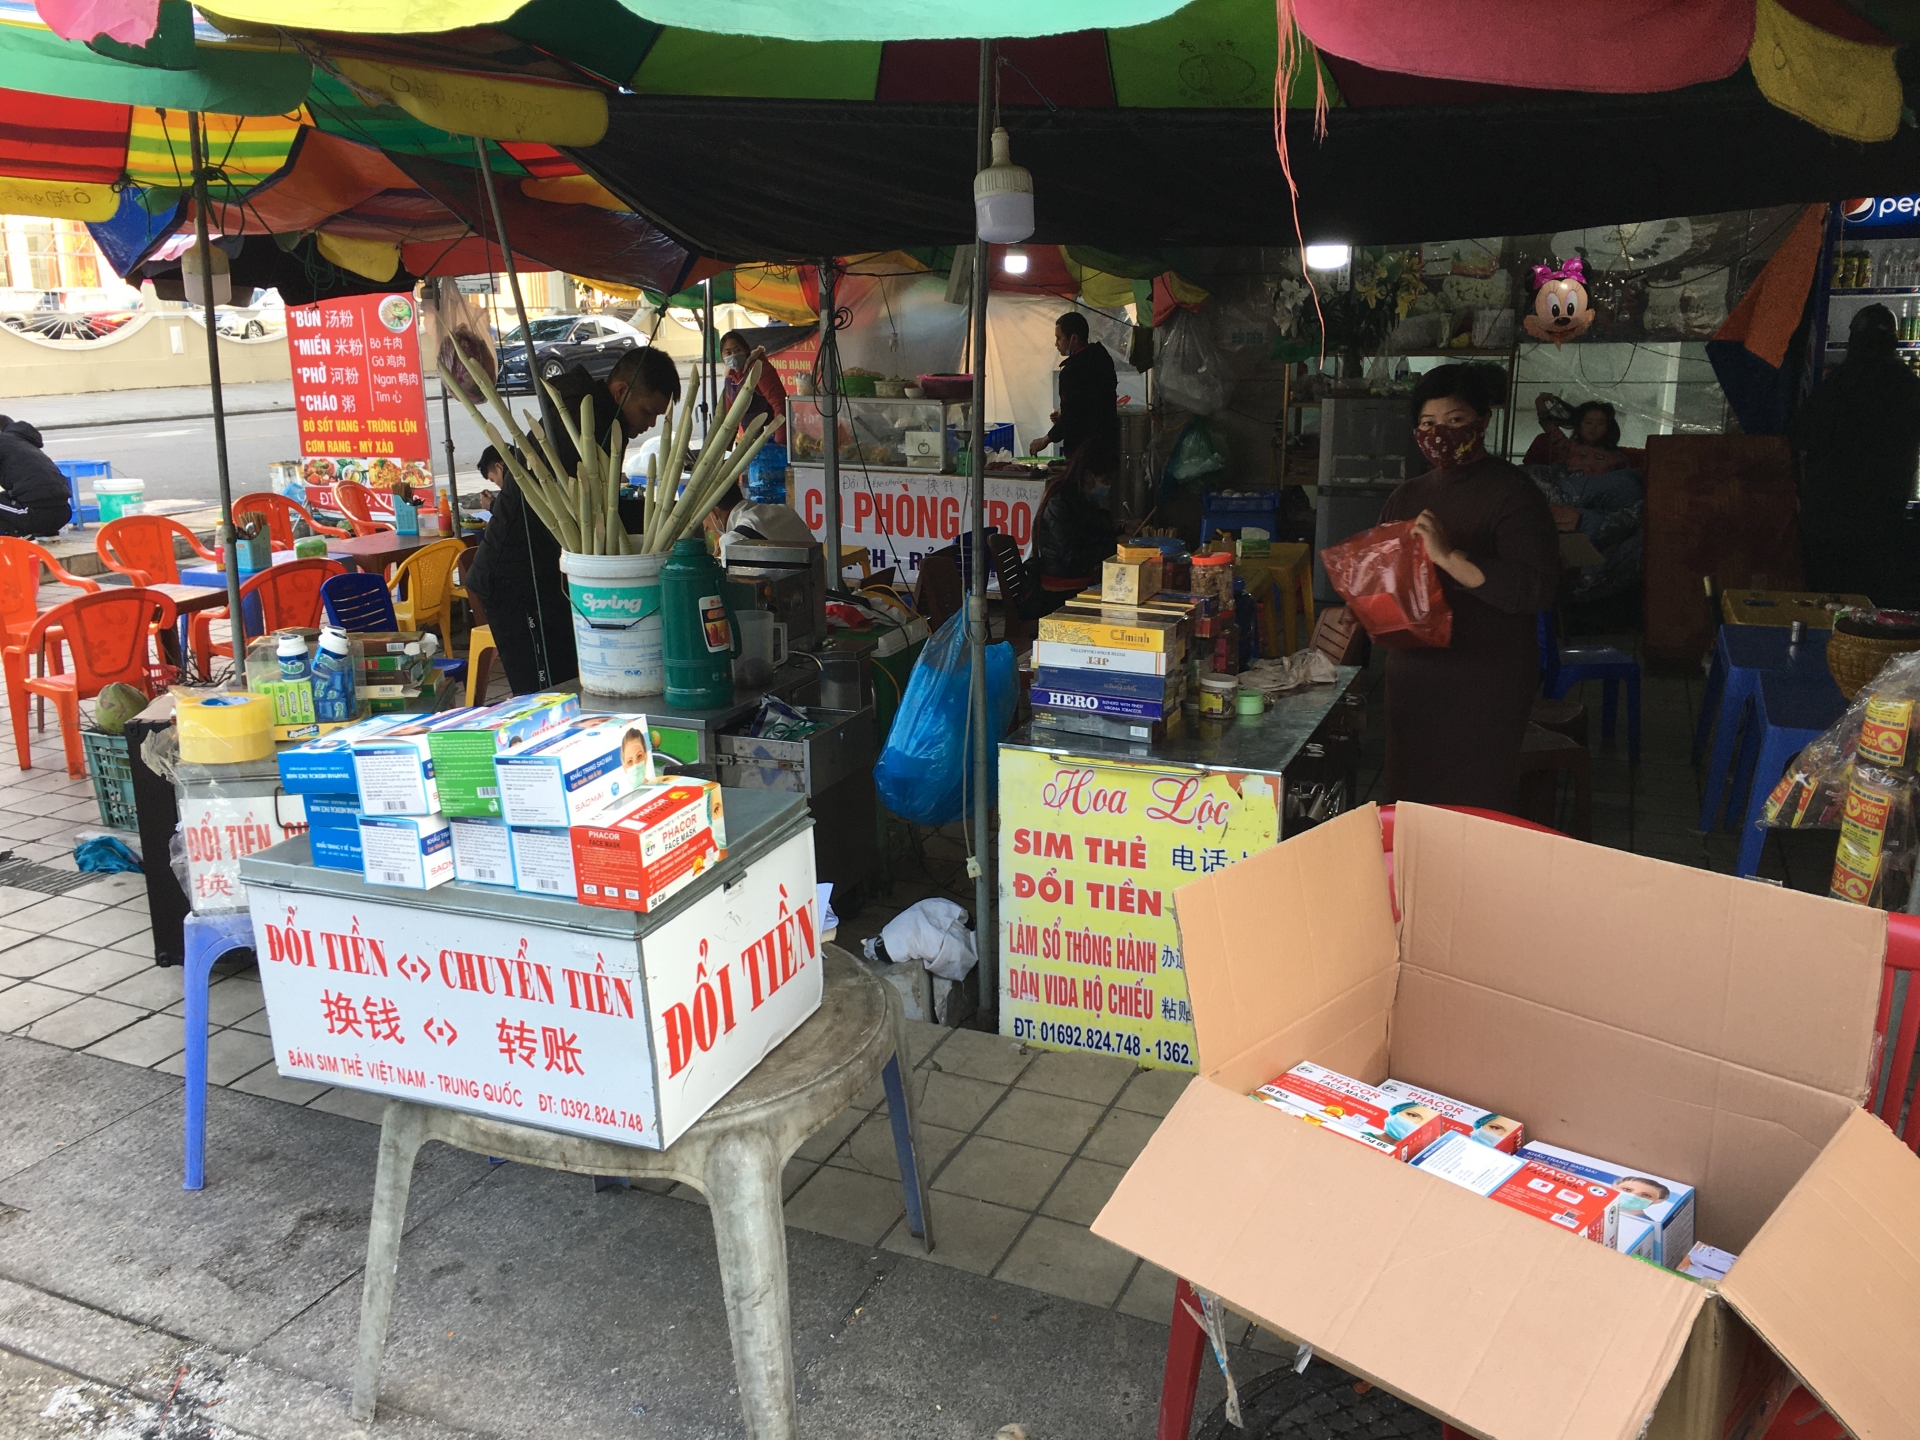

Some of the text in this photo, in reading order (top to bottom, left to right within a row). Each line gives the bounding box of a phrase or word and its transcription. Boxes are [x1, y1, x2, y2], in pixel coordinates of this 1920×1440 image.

[296, 307, 322, 327] BÚN
[325, 309, 354, 328] 汤粉
[334, 338, 363, 356] 米粉
[369, 337, 381, 349] Bò
[383, 338, 403, 350] 牛肉
[372, 355, 384, 367] Gà
[386, 355, 406, 368] 鸡肉
[302, 362, 327, 384] PHỞ
[330, 367, 359, 385] 河粉
[373, 374, 397, 387] Ngan
[398, 373, 419, 386] 鸭肉
[305, 391, 338, 412] CHÁO
[341, 394, 356, 413] 粥
[375, 391, 390, 403] Tim
[392, 392, 402, 404] 心
[303, 416, 417, 436] BÒ SỐT VANG TRỨNG LỘN
[305, 439, 325, 453] CƠM
[327, 440, 351, 453] RANG
[375, 438, 394, 453] XÀO
[854, 483, 960, 541] PHÒNG
[582, 593, 642, 613] Spring
[1086, 656, 1109, 666] JET
[1048, 692, 1099, 710] HERO
[1043, 769, 1230, 831] Hoa Lộc
[186, 811, 272, 862] ĐỔI TIỀN
[588, 830, 620, 841] PHACOR
[662, 814, 697, 843] PHACOR
[589, 839, 604, 847] FACE
[665, 828, 697, 852] FACE MASK
[1013, 828, 1147, 869] SIM THẺ
[195, 873, 234, 898] 换
[1013, 867, 1162, 917] ĐỔI TIỀN
[265, 907, 389, 978] ĐỔI TIỀN
[1009, 916, 1157, 974] LÀM SỔ THÔNG HÀNH
[439, 938, 635, 1020] CHUYỂN TIỀN
[661, 883, 816, 1079] ĐỔI TIỀN
[1009, 964, 1153, 1020] DÁN VIDA HỘ CHIẾU
[321, 990, 405, 1045] 换钱
[496, 1017, 585, 1076] 转账
[1014, 1017, 1036, 1040] ĐT:
[1040, 1021, 1141, 1057] 01692.824.748
[288, 1049, 314, 1071] BÁN
[317, 1055, 339, 1073] SIM
[341, 1053, 364, 1078] THẺ
[367, 1059, 395, 1085] VIỆT
[397, 1068, 427, 1089] NAM
[438, 1074, 480, 1098] TRUNG
[483, 1080, 523, 1108] QUỐC
[1322, 1074, 1381, 1100] PHACOR
[1275, 1089, 1290, 1099] Pcs
[1319, 1079, 1375, 1102] FACE MASK
[538, 1093, 643, 1133] ĐT: 0392.824.748
[1407, 1091, 1464, 1115] PHACOR
[1547, 1156, 1569, 1167] TRANG
[1526, 1168, 1580, 1190] FACE MASK
[1528, 1162, 1587, 1186] PHACOR
